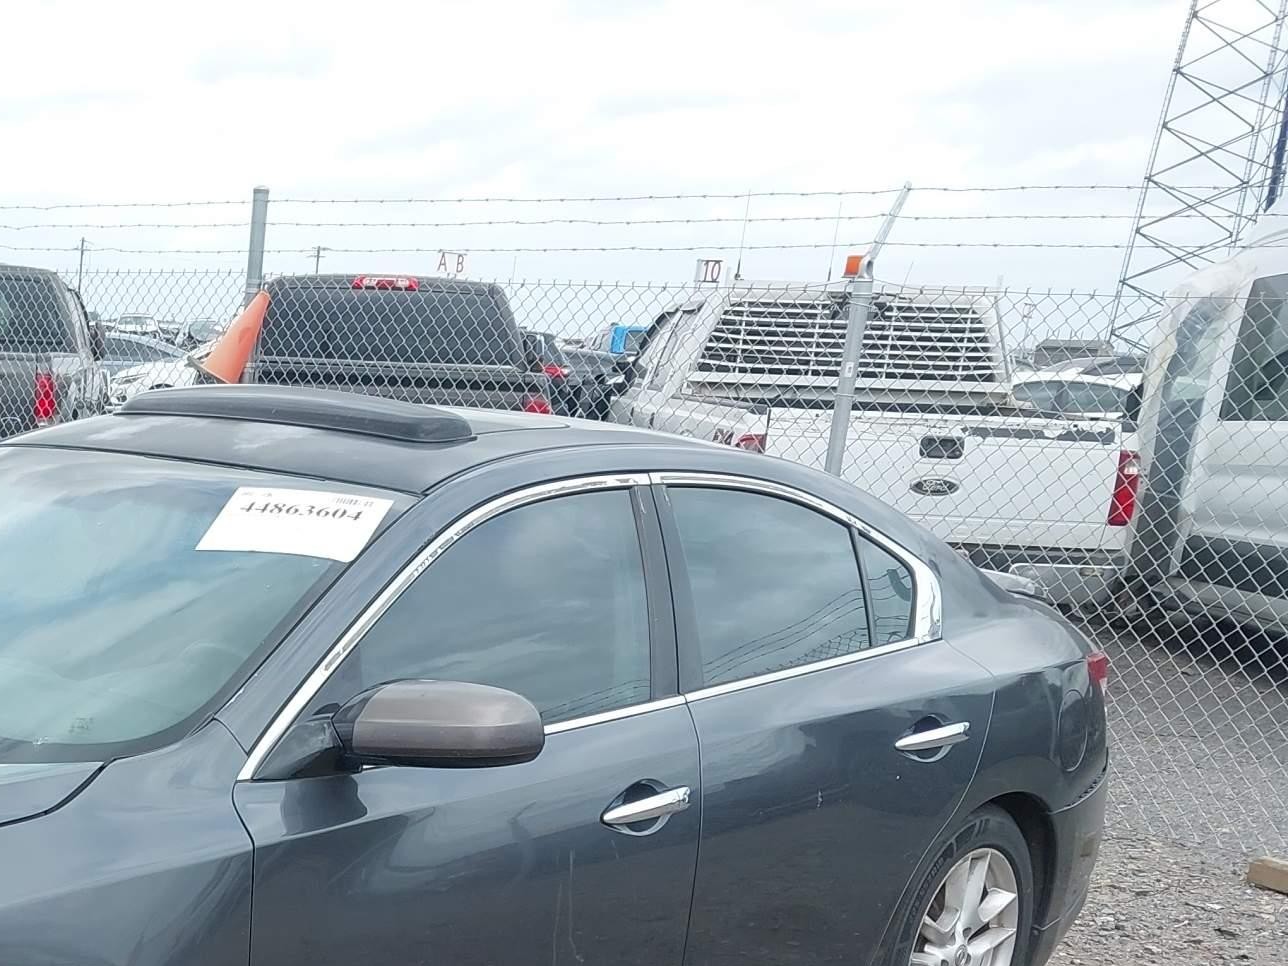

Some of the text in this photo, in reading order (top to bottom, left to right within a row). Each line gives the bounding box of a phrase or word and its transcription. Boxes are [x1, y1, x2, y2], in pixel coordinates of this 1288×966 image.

[437, 252, 464, 273] A B
[703, 260, 721, 282] 10
[240, 501, 363, 521] 44863604
